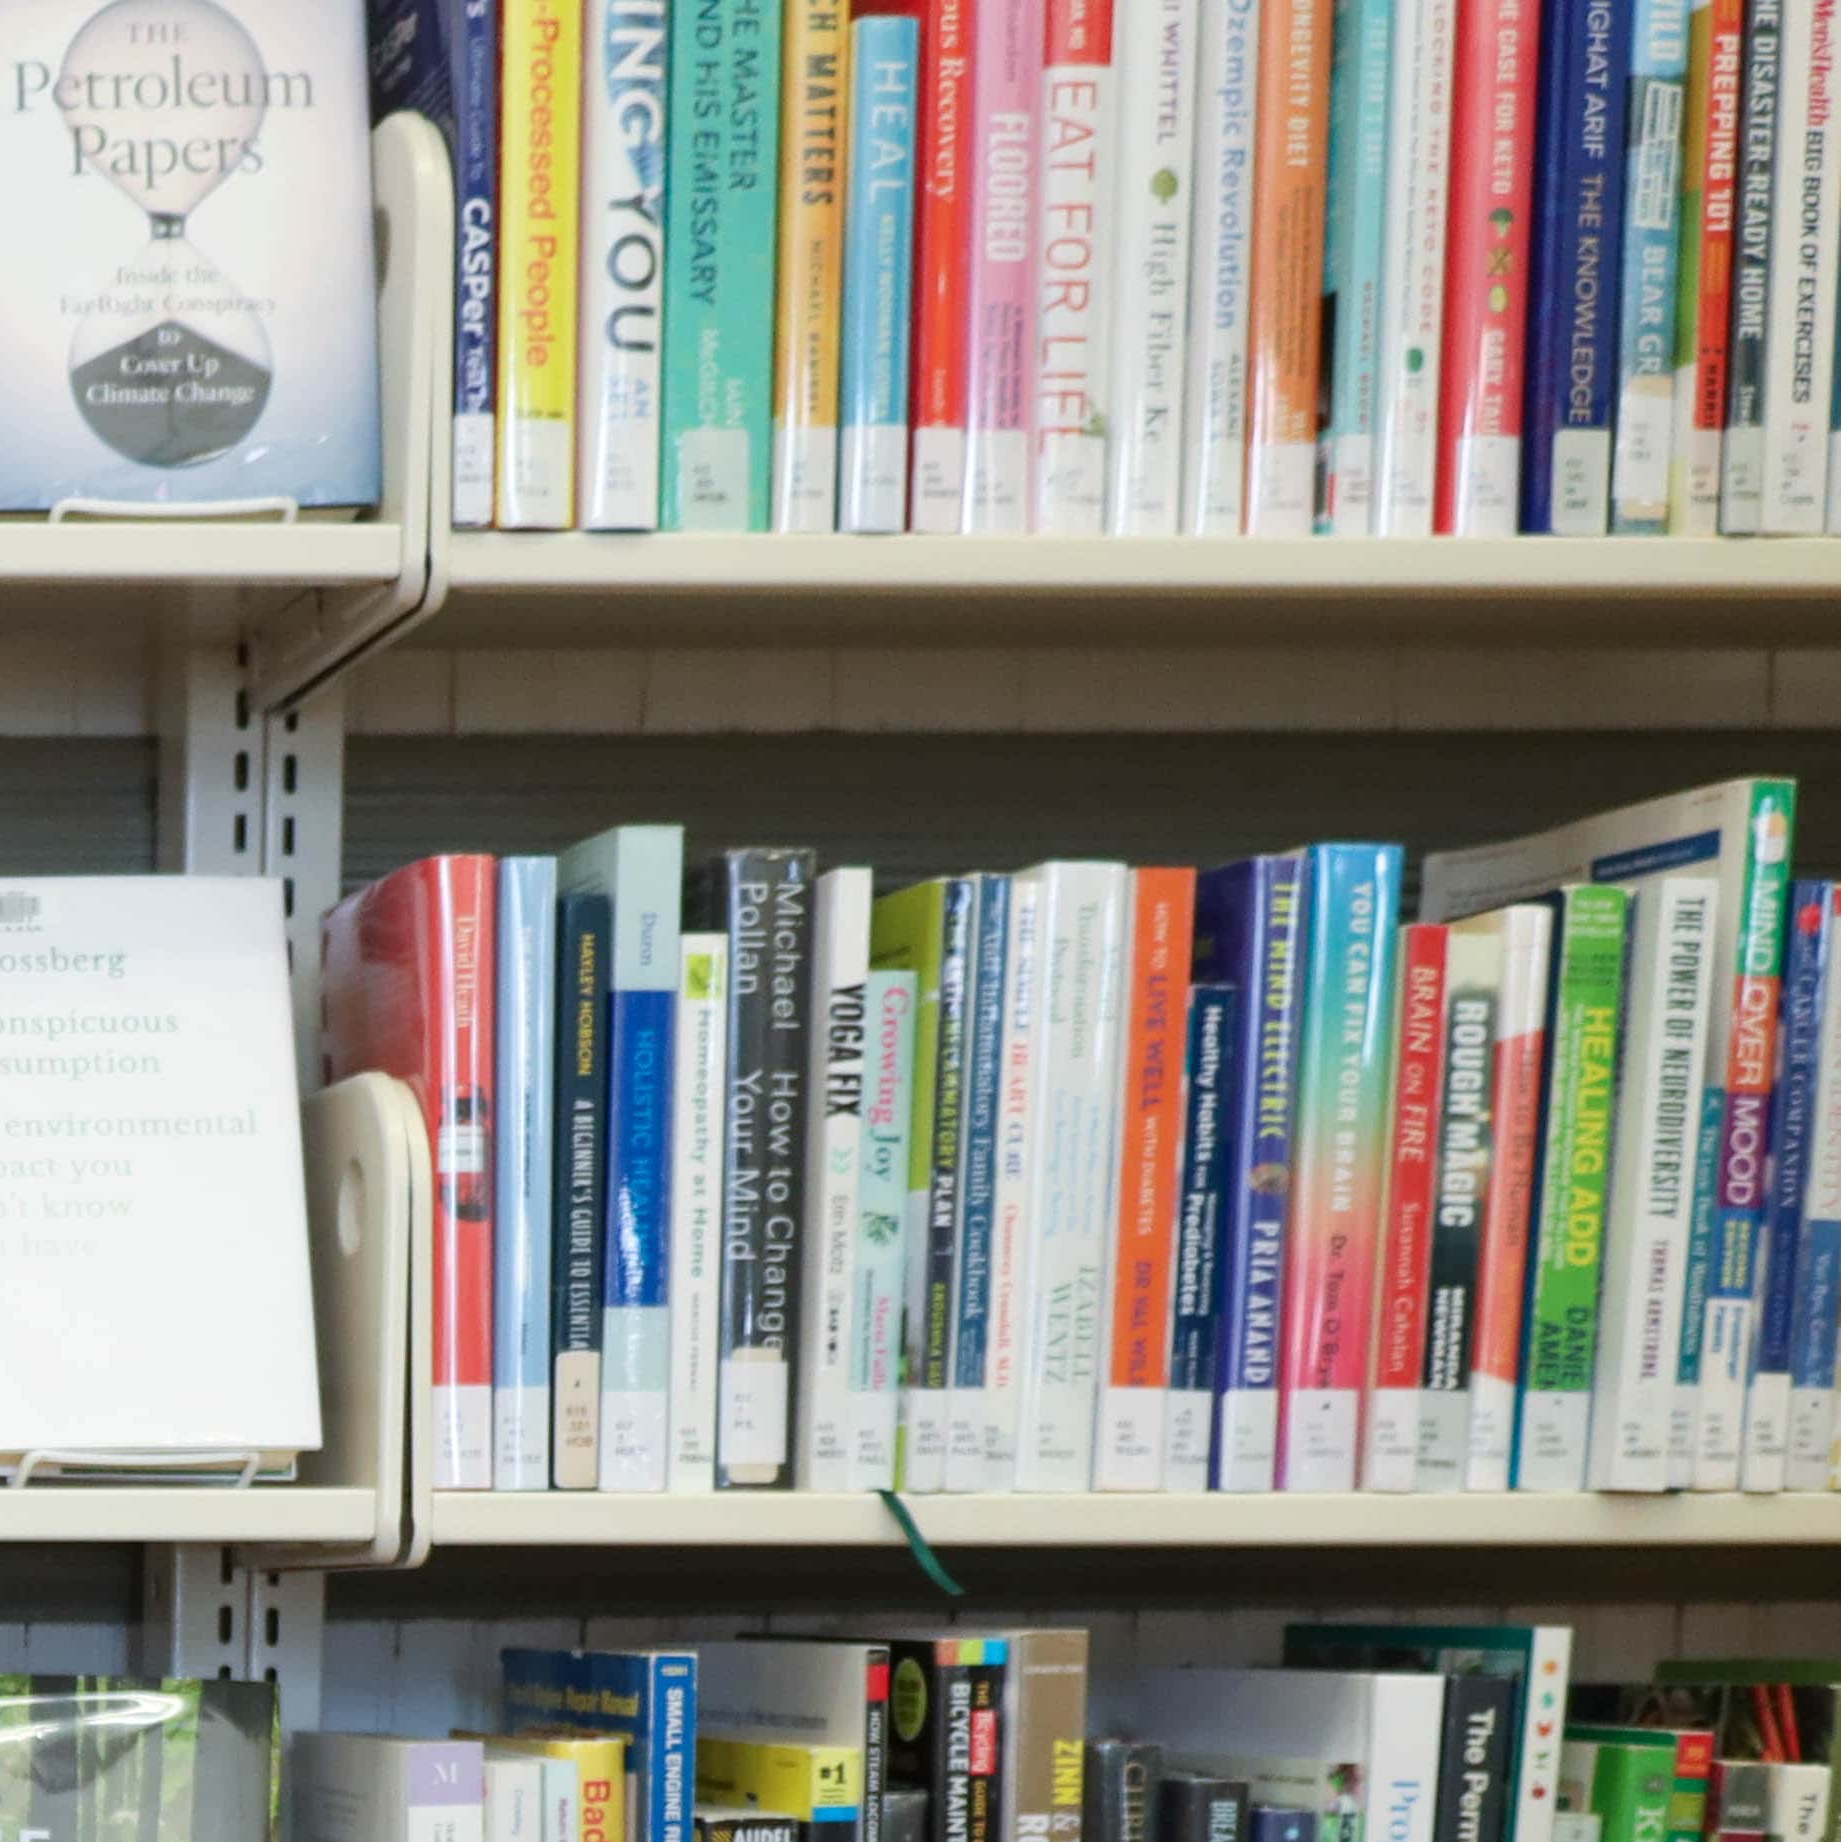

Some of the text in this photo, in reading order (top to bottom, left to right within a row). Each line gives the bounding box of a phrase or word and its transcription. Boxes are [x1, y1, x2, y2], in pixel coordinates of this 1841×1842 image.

[13, 55, 314, 113] Petroleum
[869, 60, 908, 202] HEAL
[1710, 35, 1738, 180] PREPPING
[70, 127, 264, 188] Papers
[120, 353, 220, 377] Cover Up
[519, 234, 557, 371] People
[87, 381, 254, 406] Climate Change
[736, 883, 767, 996] Pollan
[770, 883, 804, 1031] Michael
[826, 983, 865, 1119] YOGA FIX
[1728, 882, 1777, 1204] MIND OVER MOOD
[4, 1111, 258, 1138] environmental
[69, 1158, 132, 1182] you
[728, 1073, 759, 1262] Your Mind
[1567, 1008, 1614, 1266] HEALING ADD
[757, 1073, 799, 1349] How to Change
[1464, 1708, 1495, 1767] The
